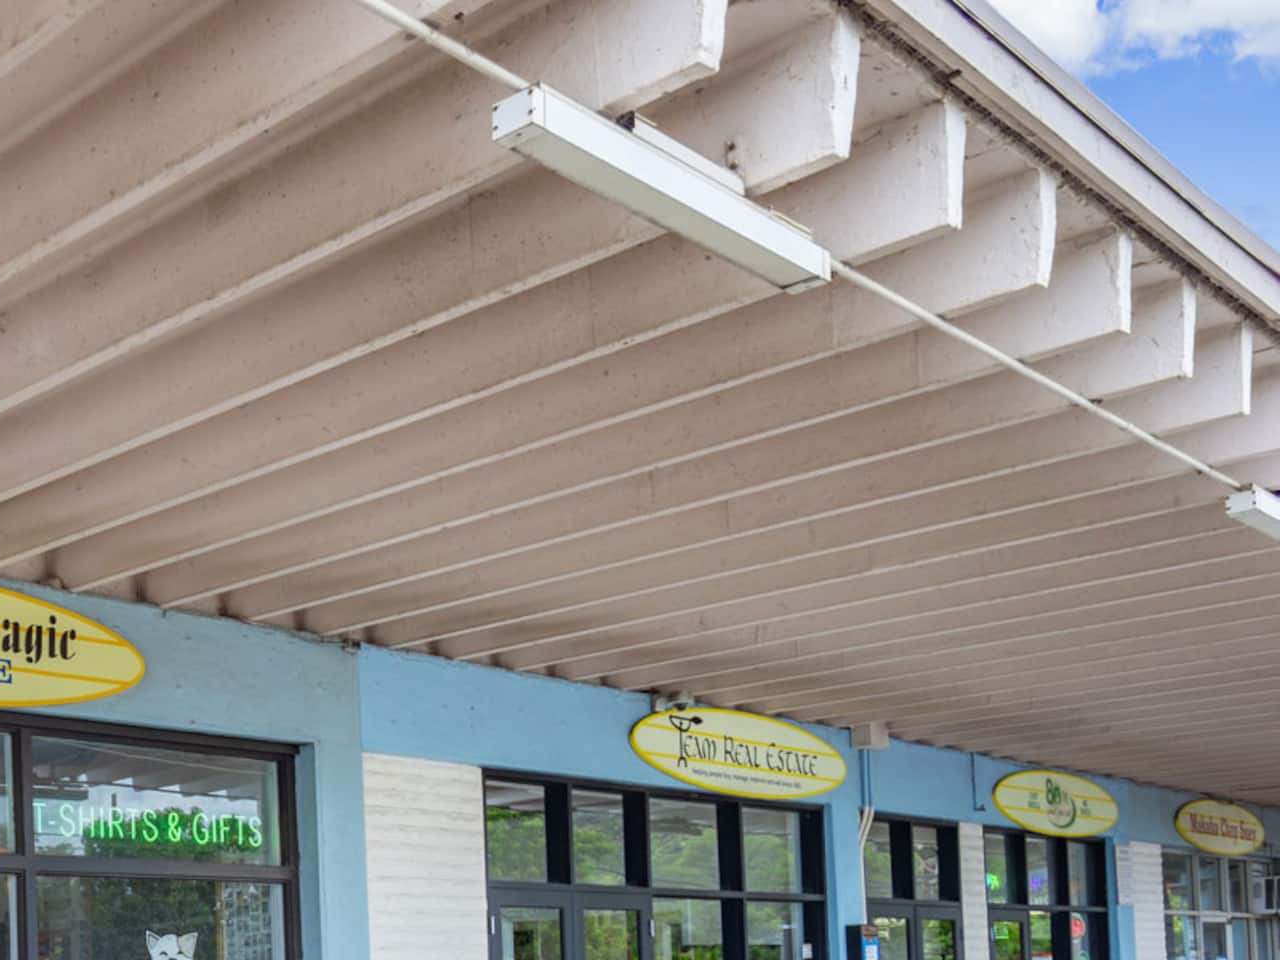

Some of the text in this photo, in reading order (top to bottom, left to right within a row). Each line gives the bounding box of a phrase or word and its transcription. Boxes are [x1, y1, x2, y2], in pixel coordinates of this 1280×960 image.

[32, 802, 264, 848] T-SHIRTS & GIFTS
